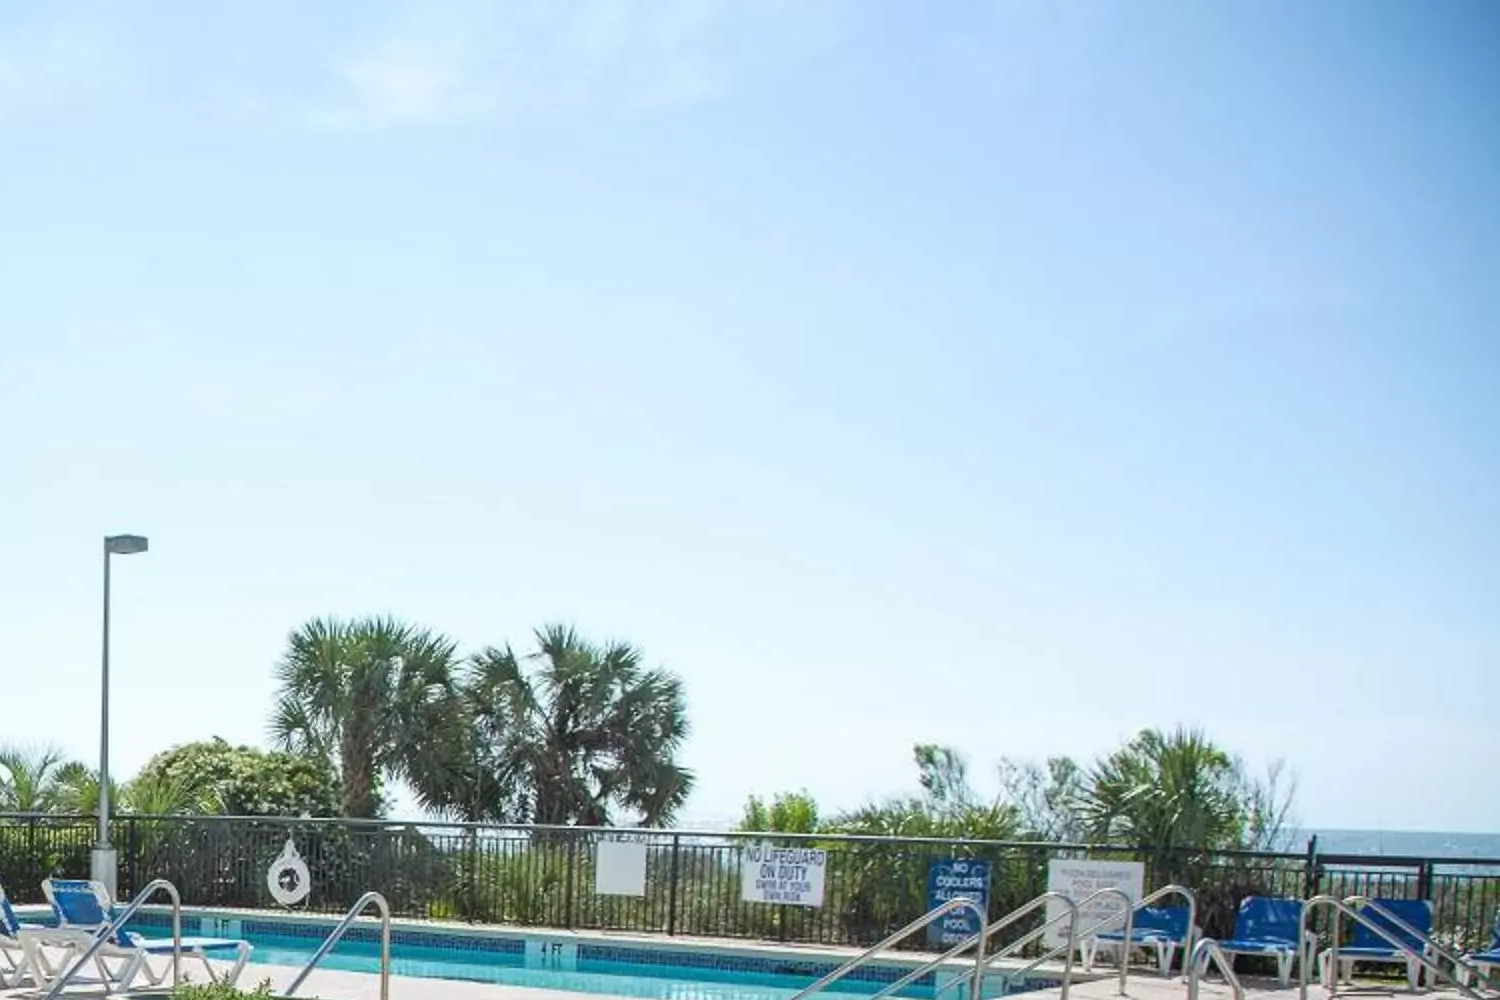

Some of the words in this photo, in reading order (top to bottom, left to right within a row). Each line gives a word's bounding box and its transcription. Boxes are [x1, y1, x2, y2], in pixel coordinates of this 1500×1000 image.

[746, 846, 761, 863] NO
[763, 848, 825, 867] LIFEGUARD
[760, 864, 776, 879] ON
[778, 866, 807, 881] DUTY
[953, 862, 969, 873] NO
[935, 875, 984, 889] COOLERS
[944, 919, 971, 931] POOL
